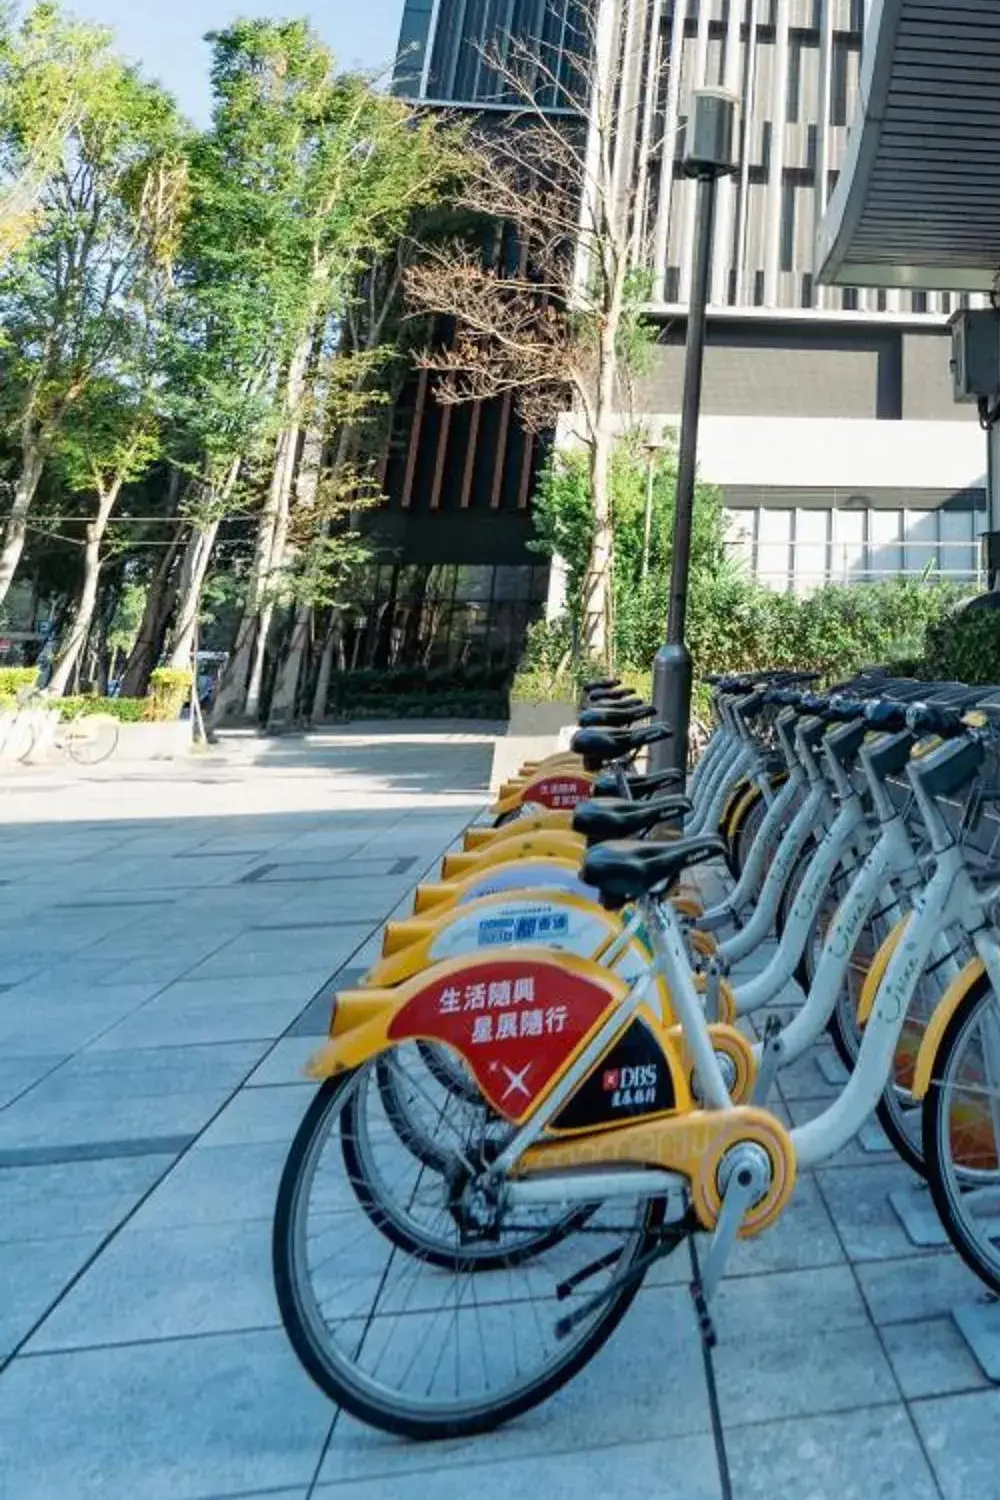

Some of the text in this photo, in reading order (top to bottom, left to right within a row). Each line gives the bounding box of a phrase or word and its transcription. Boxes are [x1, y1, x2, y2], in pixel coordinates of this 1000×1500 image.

[438, 977, 536, 1015] 生活隨興
[471, 1006, 569, 1044] 星展隨行
[621, 1063, 657, 1089] DBS
